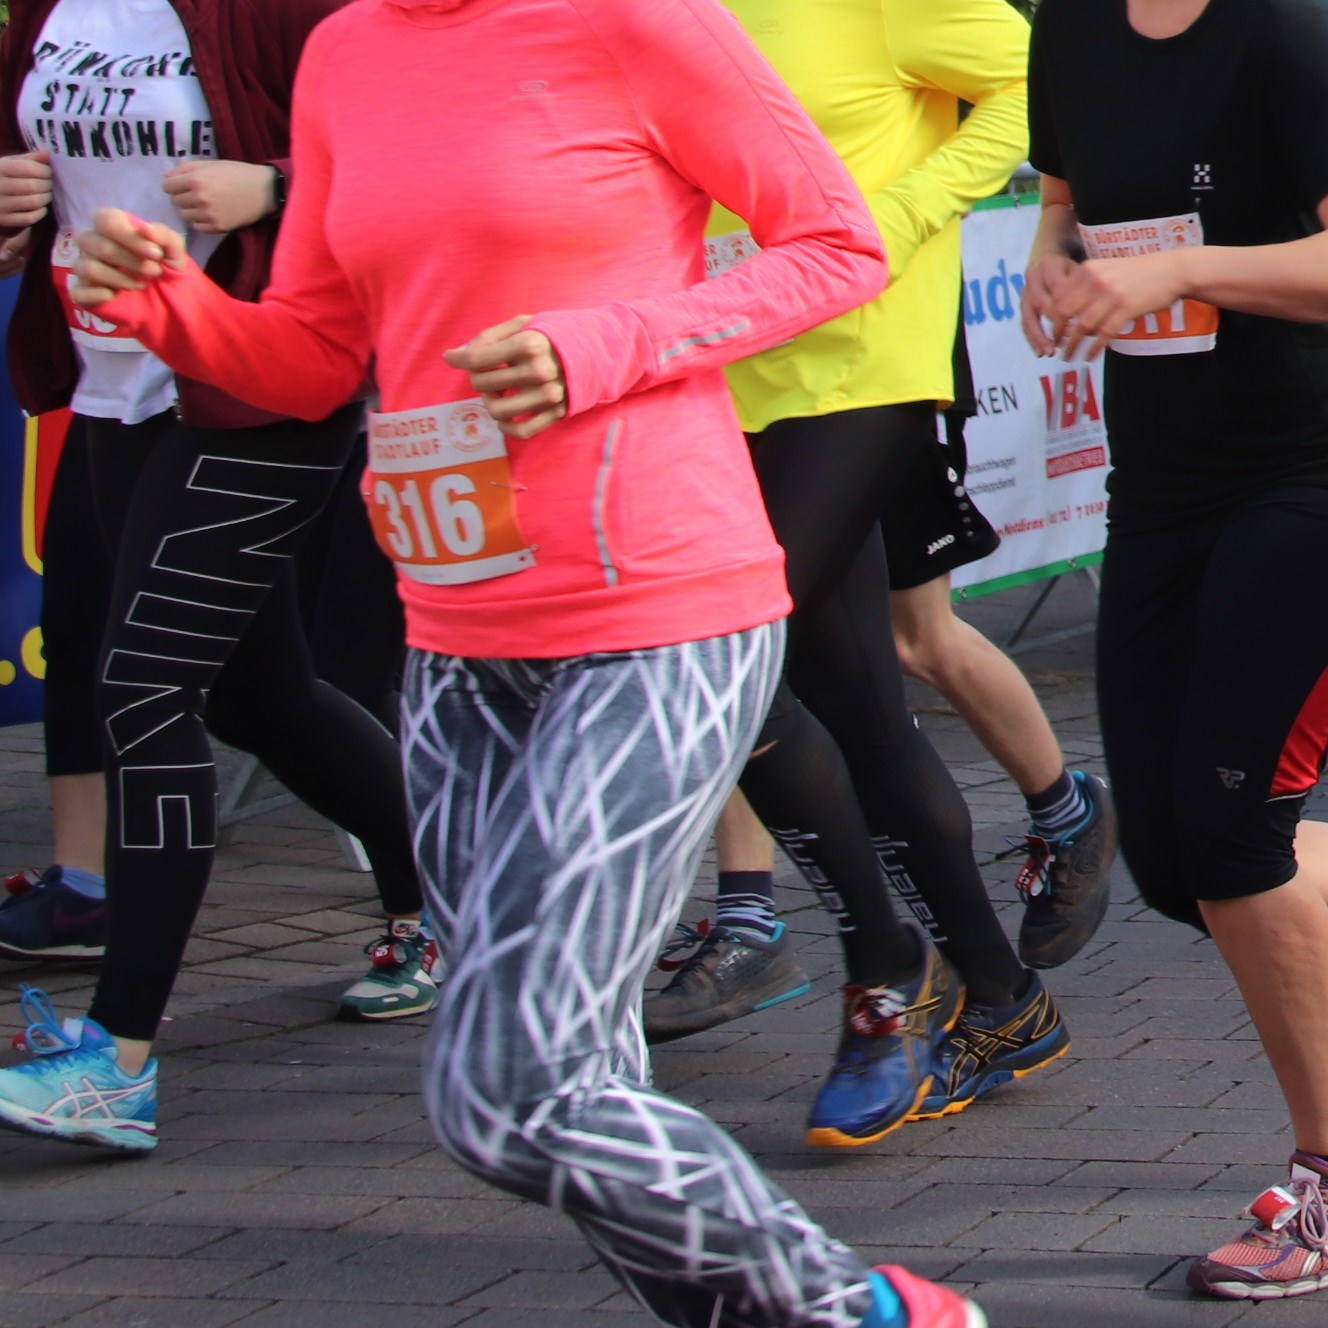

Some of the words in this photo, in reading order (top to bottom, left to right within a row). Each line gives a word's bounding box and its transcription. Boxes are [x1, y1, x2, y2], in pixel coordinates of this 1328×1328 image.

[41, 80, 136, 116] STATT
[24, 119, 211, 159] UNKOHLE
[1096, 225, 1159, 245] BÜRSTÄDTER
[374, 473, 486, 559] 316
[926, 533, 956, 555] JAKO
